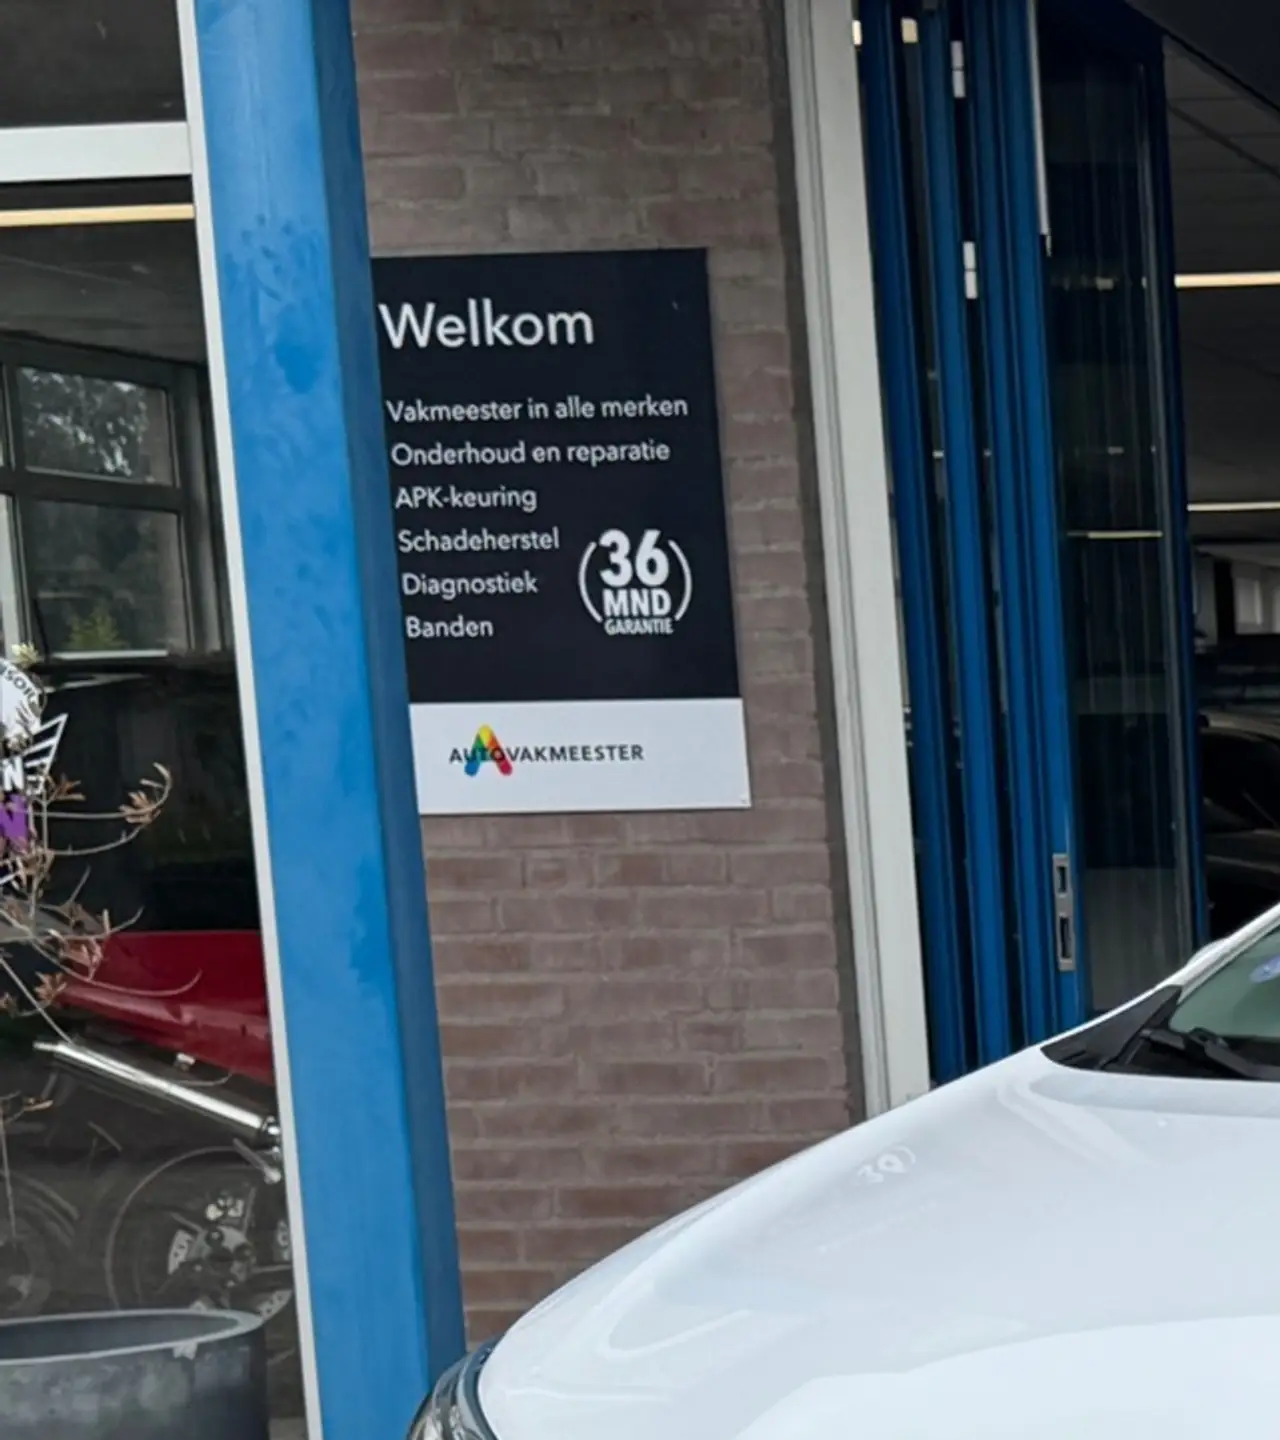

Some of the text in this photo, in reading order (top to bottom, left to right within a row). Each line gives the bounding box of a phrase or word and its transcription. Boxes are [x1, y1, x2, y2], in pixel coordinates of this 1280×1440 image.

[378, 298, 594, 349] Welkom
[386, 393, 688, 423] Vakmeester in alle merken
[391, 438, 671, 468] Onderhoud en reparatie
[395, 485, 537, 513] APK-keuring
[398, 526, 560, 553] Schadeherstel
[599, 528, 669, 587] 36
[402, 570, 538, 600] Diagnostiek
[602, 588, 671, 617] MND
[405, 614, 494, 638] Banden
[604, 617, 674, 635] GARANTIE
[449, 744, 644, 765] AUTOVAKMEESTER
